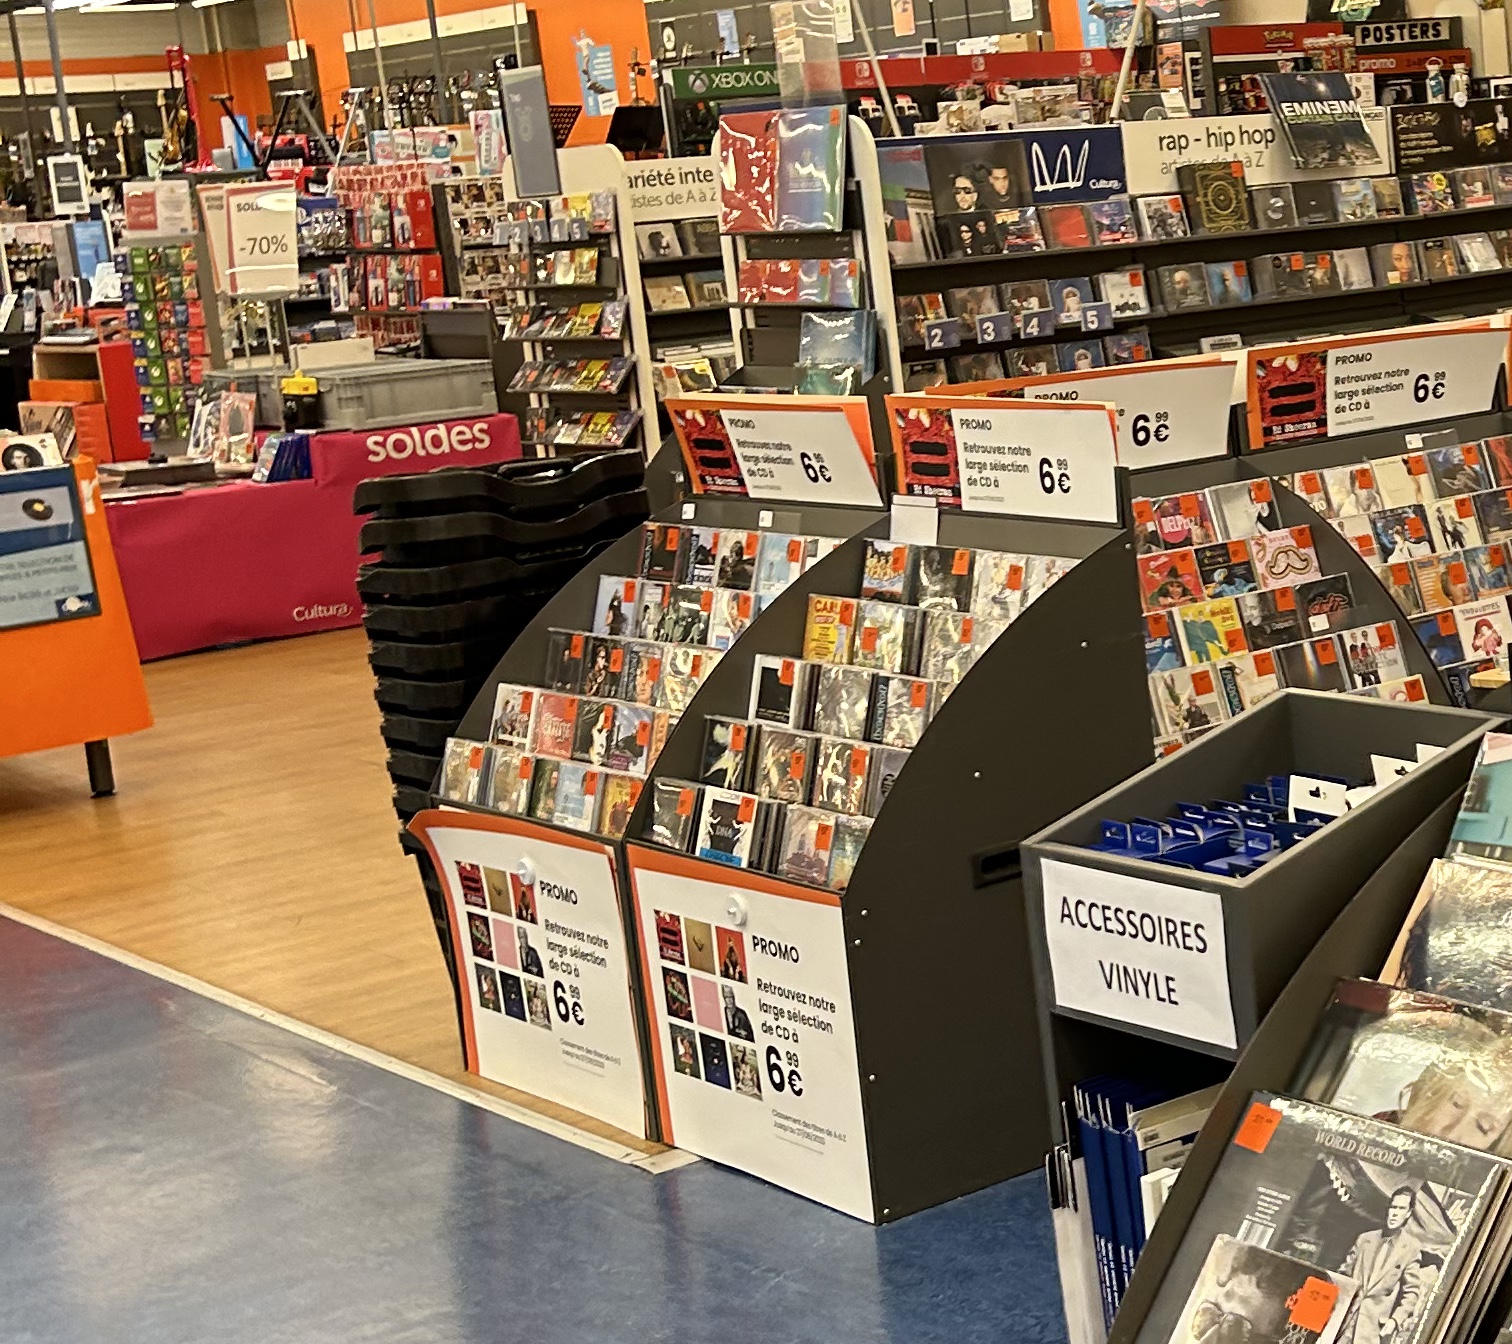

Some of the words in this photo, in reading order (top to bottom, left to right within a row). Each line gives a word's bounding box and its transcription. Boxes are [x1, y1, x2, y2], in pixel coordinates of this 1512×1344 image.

[1361, 22, 1442, 43] POSTERS
[1359, 57, 1397, 70] promo
[711, 71, 755, 90] XBOX
[1158, 132, 1190, 154] rap
[1206, 127, 1235, 152] hip
[1240, 124, 1276, 147] hop
[679, 167, 715, 185] inte
[666, 190, 683, 204] de
[685, 190, 696, 203] A
[552, 226, 561, 241] 4
[239, 234, 289, 255] -70%
[1026, 317, 1039, 335] 4
[1086, 310, 1099, 329] 5
[930, 329, 943, 348] 2
[982, 322, 995, 341] 3
[1335, 353, 1372, 366] PROMO
[1334, 372, 1383, 386] Retrouvez
[1384, 367, 1410, 379] notre
[1334, 388, 1360, 402] large
[1361, 381, 1404, 395] sélection
[1414, 373, 1429, 403] 6
[1335, 404, 1347, 414] de
[1349, 402, 1362, 412] CD
[960, 418, 992, 432] PROMO
[1132, 414, 1150, 447] 6
[366, 420, 491, 464] soldes
[963, 441, 1007, 455] Retrouvez
[1008, 445, 1032, 457] notre
[800, 451, 819, 483] 6
[965, 458, 993, 473] large
[995, 460, 1029, 474] sélection
[1039, 457, 1055, 495] 6
[979, 476, 992, 488] CD
[293, 602, 353, 624] Cultura
[539, 880, 578, 905] PROMO
[545, 918, 586, 943] Retrouvez
[586, 934, 609, 949] notre
[1060, 896, 1208, 954] ACCESSOIRES
[546, 937, 568, 959] large
[570, 945, 607, 968] sélection
[752, 935, 800, 964] PROMO
[560, 961, 572, 975] CD
[1098, 959, 1180, 1006] VINYLE
[553, 980, 570, 1023] 6
[756, 977, 807, 1005] Retrouvez
[808, 990, 836, 1013] notre
[758, 998, 785, 1022] large
[787, 1007, 833, 1034] sélection
[761, 1021, 774, 1036] de
[775, 1025, 790, 1041] CD
[766, 1045, 786, 1093] 6
[786, 1050, 799, 1068] 99
[1315, 1129, 1357, 1154] WORLD
[1358, 1142, 1406, 1167] RECORD
